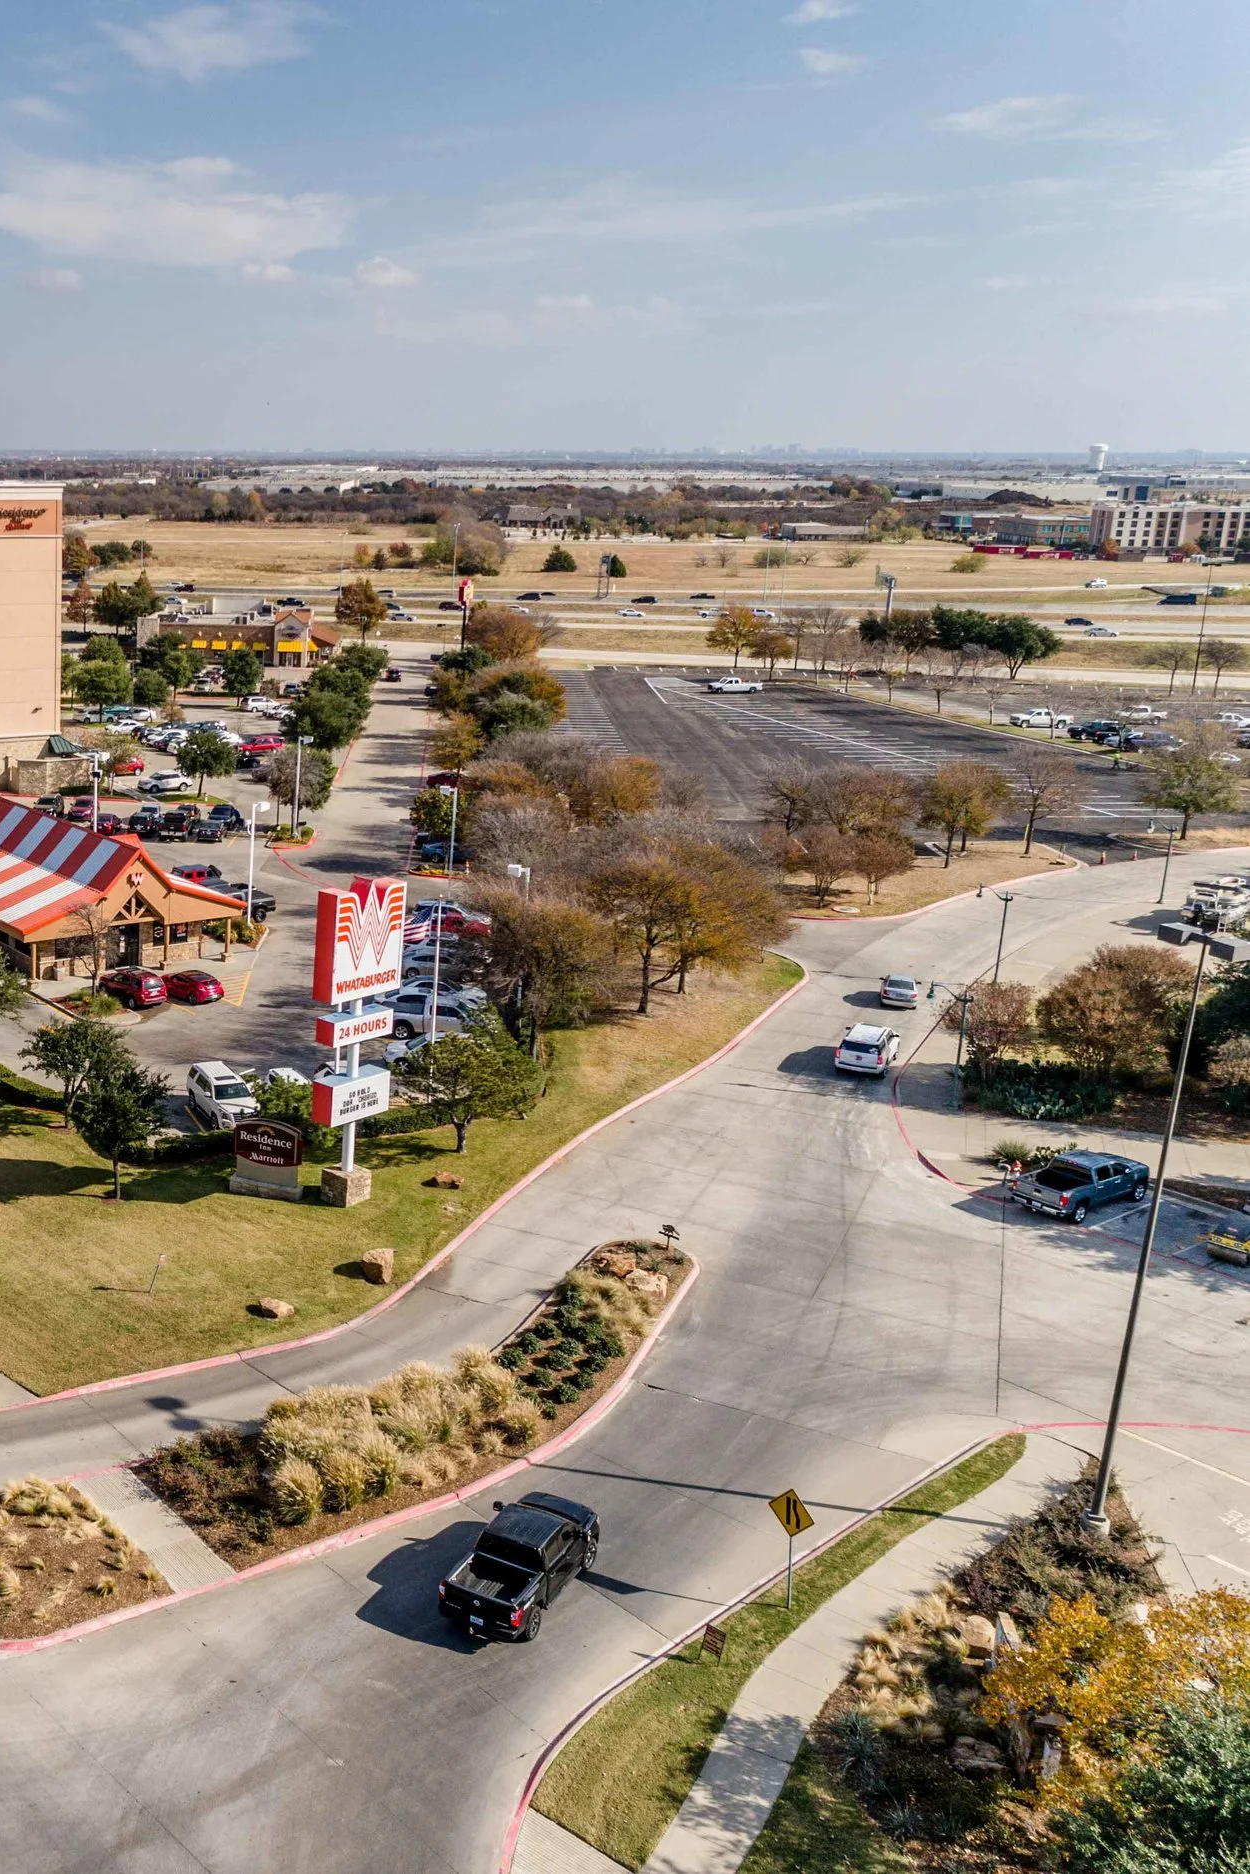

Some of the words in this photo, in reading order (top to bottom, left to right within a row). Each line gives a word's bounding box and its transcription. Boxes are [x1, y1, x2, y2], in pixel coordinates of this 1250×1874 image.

[336, 969, 397, 995] WHATABURGER
[339, 1026, 351, 1040] 24
[353, 1017, 387, 1036] HOURS
[340, 1104, 359, 1115] BURGER
[361, 1101, 366, 1109] IS
[367, 1098, 378, 1107] HERE
[240, 1130, 292, 1148] Residence
[259, 1143, 272, 1151] Inn
[249, 1152, 284, 1165] Marriott
